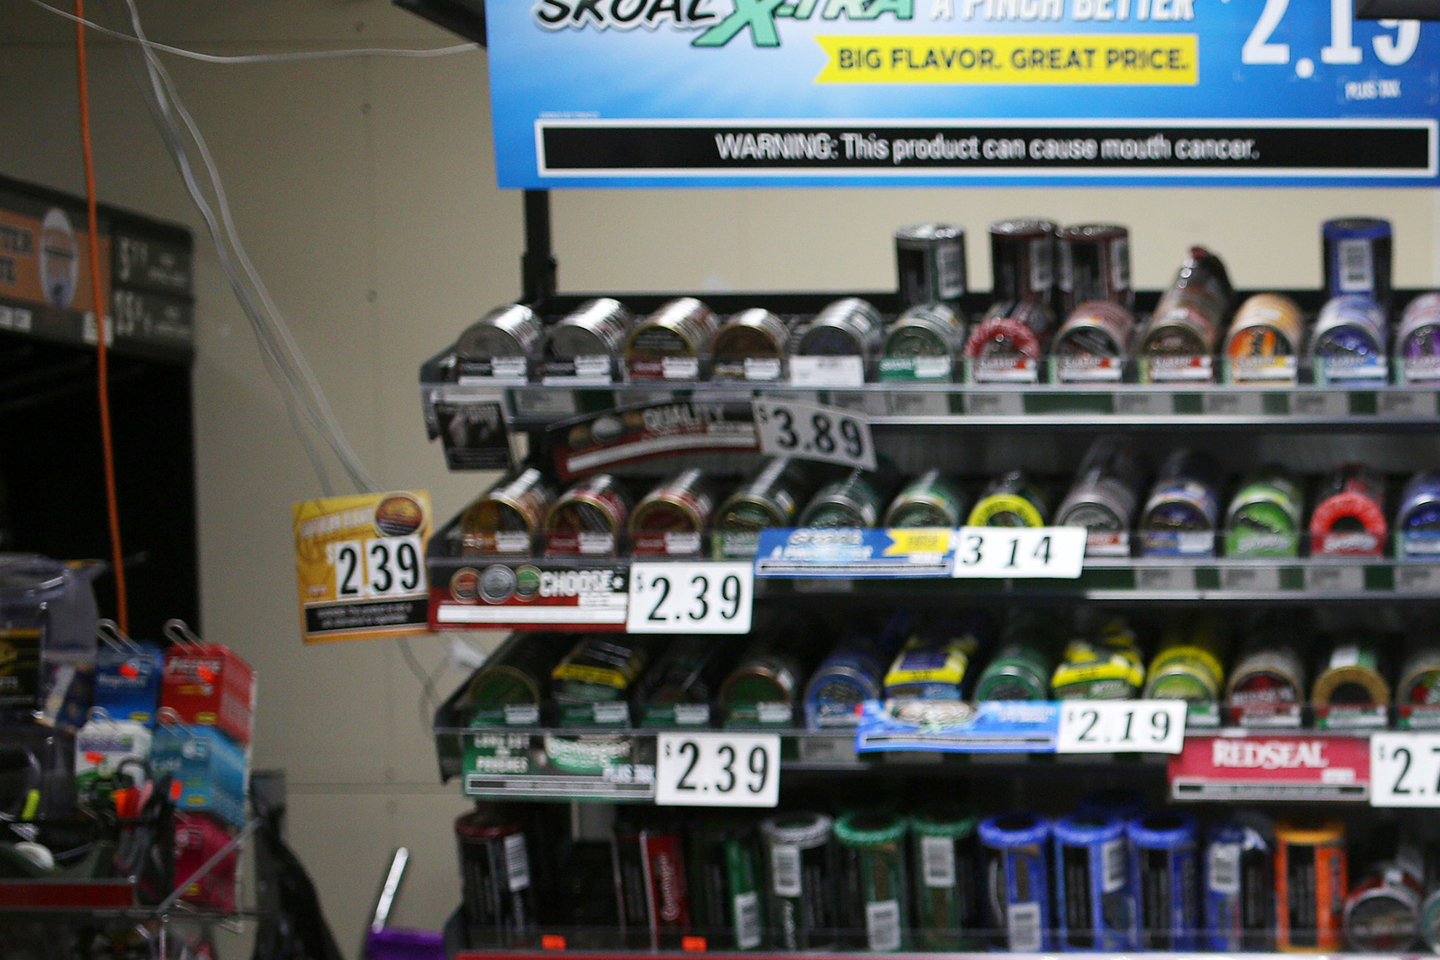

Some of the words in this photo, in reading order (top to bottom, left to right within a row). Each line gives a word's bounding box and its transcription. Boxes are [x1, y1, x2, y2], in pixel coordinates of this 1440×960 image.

[839, 49, 882, 69] BIG
[891, 49, 1001, 70] FLAVOR.
[1010, 48, 1099, 69] GREAT
[1106, 48, 1189, 69] PRICE.
[715, 133, 839, 160] WARNING:
[840, 133, 889, 160] This
[893, 133, 980, 164] product
[983, 138, 1025, 160] can
[1029, 138, 1098, 160] cause
[1100, 134, 1171, 160] mouth
[1174, 138, 1260, 160] cancer.
